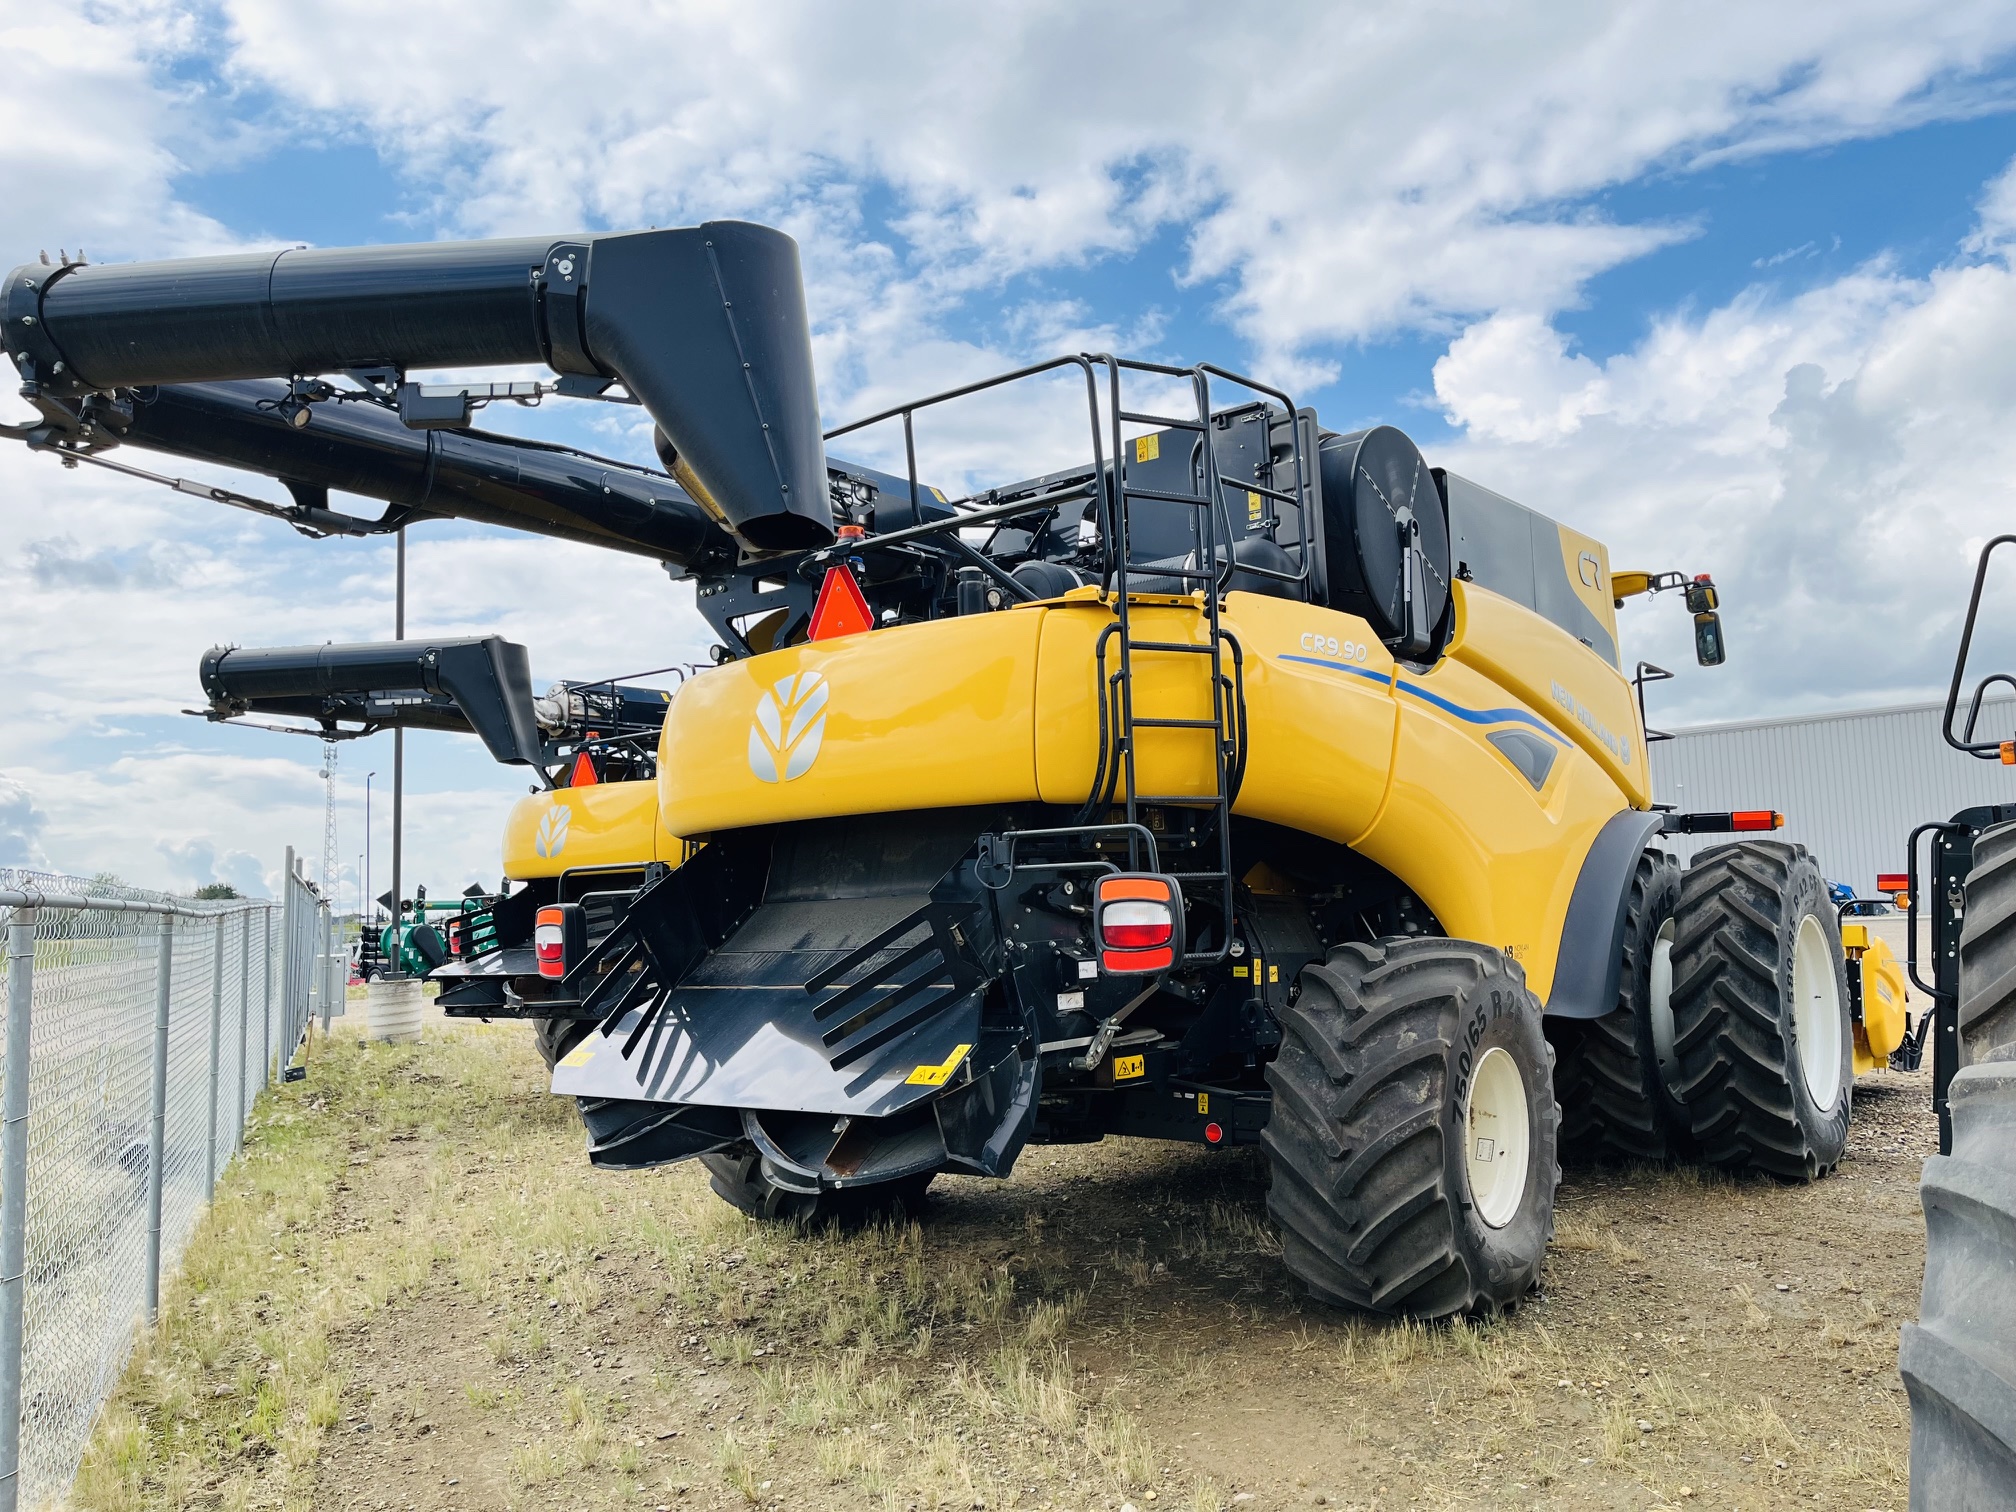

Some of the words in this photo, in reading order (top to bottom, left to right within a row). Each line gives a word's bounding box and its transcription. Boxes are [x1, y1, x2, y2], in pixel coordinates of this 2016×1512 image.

[1300, 632, 1367, 662] CR9.90
[1550, 678, 1575, 715] NEW
[1577, 702, 1619, 756] HOLLAND
[1786, 916, 1796, 1004] 580/85
[1452, 1004, 1487, 1125] 750/65
[1490, 990, 1503, 1020] R
[1506, 990, 1525, 1025] 26
